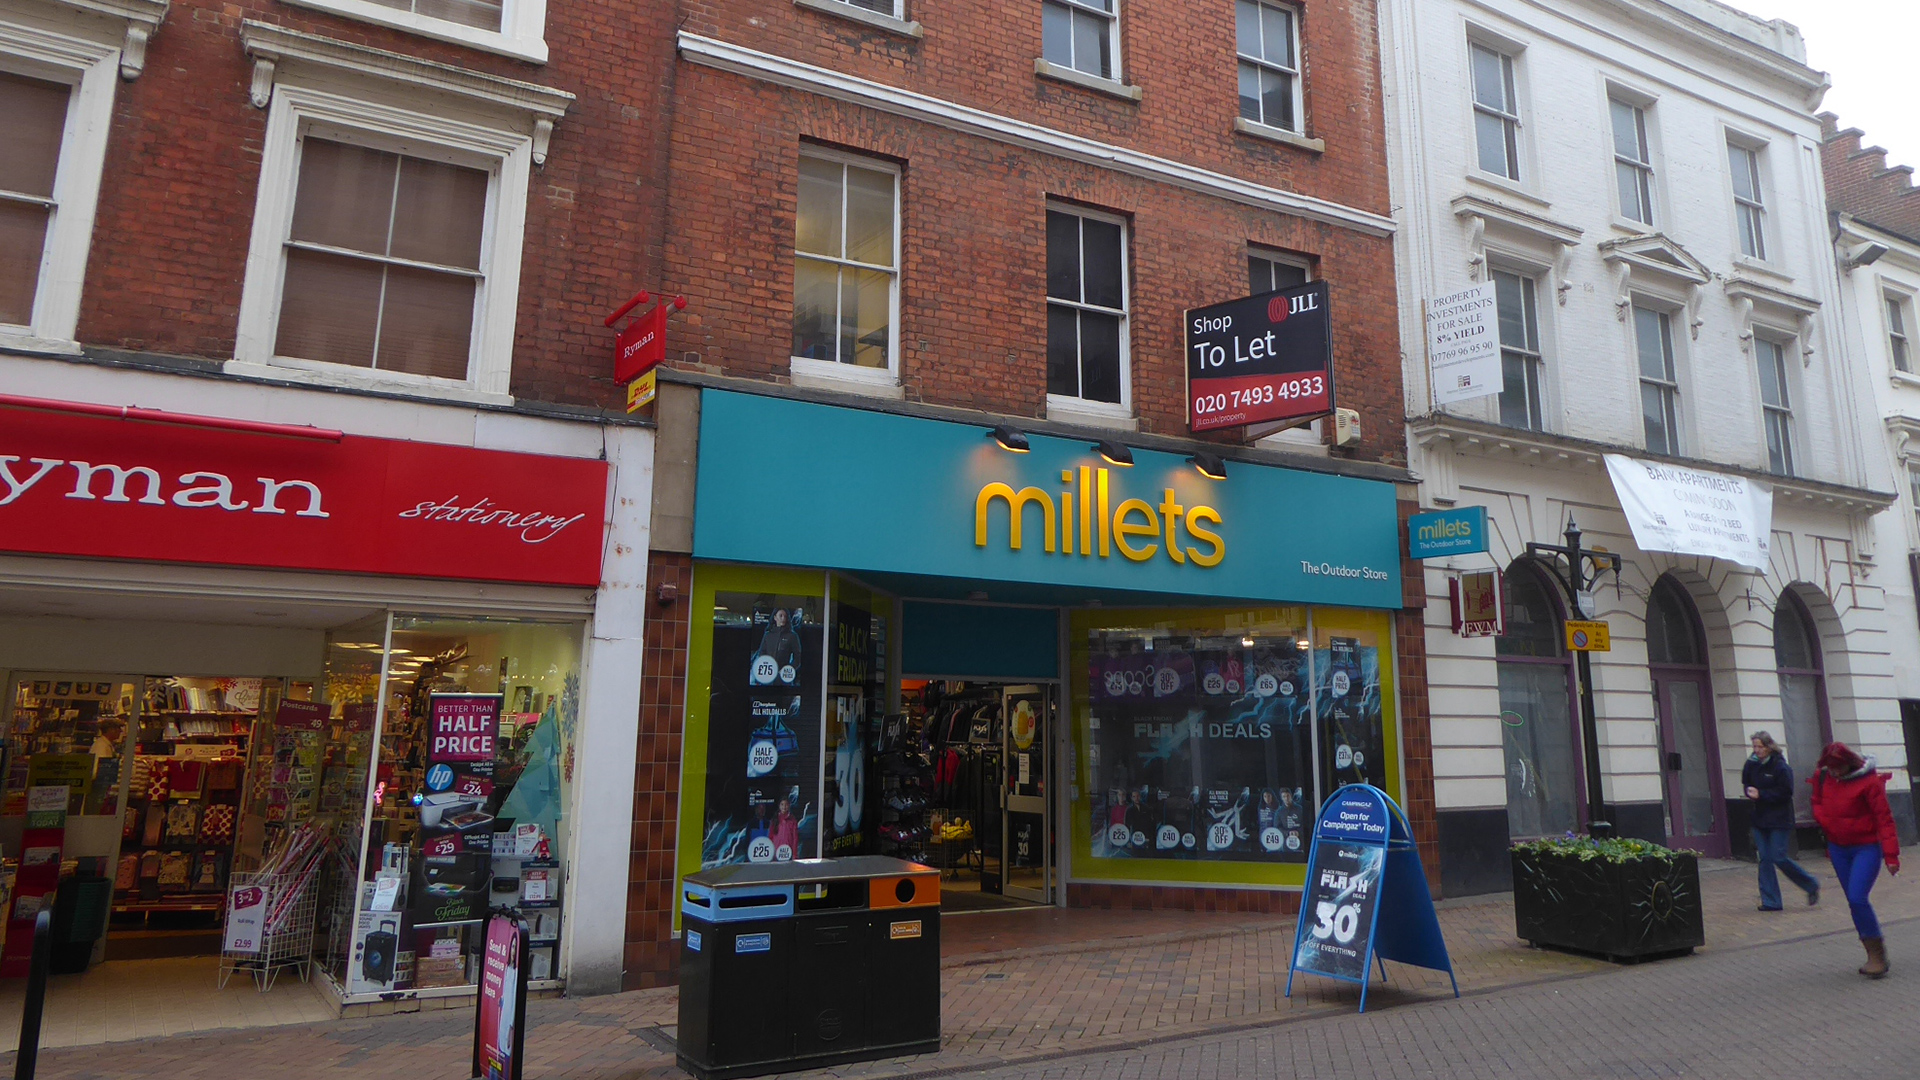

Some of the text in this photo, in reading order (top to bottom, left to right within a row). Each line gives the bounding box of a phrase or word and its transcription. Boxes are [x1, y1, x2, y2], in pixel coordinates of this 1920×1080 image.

[1433, 287, 1482, 308] PROPERTY
[1426, 298, 1493, 322] INVESTMENTS
[1193, 315, 1232, 335] Shop
[1437, 312, 1482, 332] FOR SALE
[1436, 325, 1485, 345] 8% YIELD
[623, 331, 655, 358] Ryman
[1193, 330, 1277, 370] To Let
[1432, 340, 1493, 363] 07769 96 95 90
[1195, 376, 1324, 415] 020 7493 4933
[1196, 412, 1247, 428] jll.co.uk/property
[1646, 466, 1744, 495] BANK APARTMENTS
[1708, 496, 1737, 512] SOON
[399, 494, 587, 543] stationery
[975, 465, 1225, 567] millets
[1728, 519, 1742, 529] BED
[1418, 517, 1472, 541] millets
[1419, 538, 1472, 550] The Outdoor Store
[1300, 560, 1388, 581] The Outdoor Store
[1465, 620, 1498, 634] EWM
[839, 621, 869, 655] BLACK
[757, 664, 773, 676] £75
[838, 653, 868, 685] FRIDAY
[1160, 682, 1174, 691] OFF
[1207, 680, 1221, 688] £25
[1260, 681, 1273, 690] £65
[1335, 682, 1348, 690] PRICE
[281, 700, 318, 712] Postcards
[438, 704, 493, 713] BETTER THAN
[762, 708, 787, 716] HOLDALLS
[438, 715, 491, 732] HALF
[1209, 723, 1272, 739] DEALS
[434, 736, 492, 753] PRICE
[755, 747, 773, 756] HALF
[753, 757, 774, 766] PRICE
[429, 763, 451, 791] hp
[463, 784, 482, 795] £24
[833, 751, 865, 832] 30
[1341, 800, 1372, 808] CAMPINGAZ
[1340, 811, 1370, 821] Open for
[1112, 831, 1126, 840] £25
[1362, 822, 1385, 834] Today
[1162, 832, 1176, 841] £40
[1214, 834, 1228, 844] OFF
[1266, 834, 1280, 844] £49
[435, 842, 455, 855] £29
[753, 846, 770, 858] £25
[1343, 851, 1358, 859] millets
[238, 891, 254, 904] 3 2
[435, 905, 470, 921] Friday
[234, 938, 252, 948] £2.99
[489, 939, 507, 957] Send &
[1309, 941, 1357, 958] OFF EVERYTHING
[487, 955, 505, 972] receive
[486, 970, 502, 988] money
[485, 983, 496, 999] here
